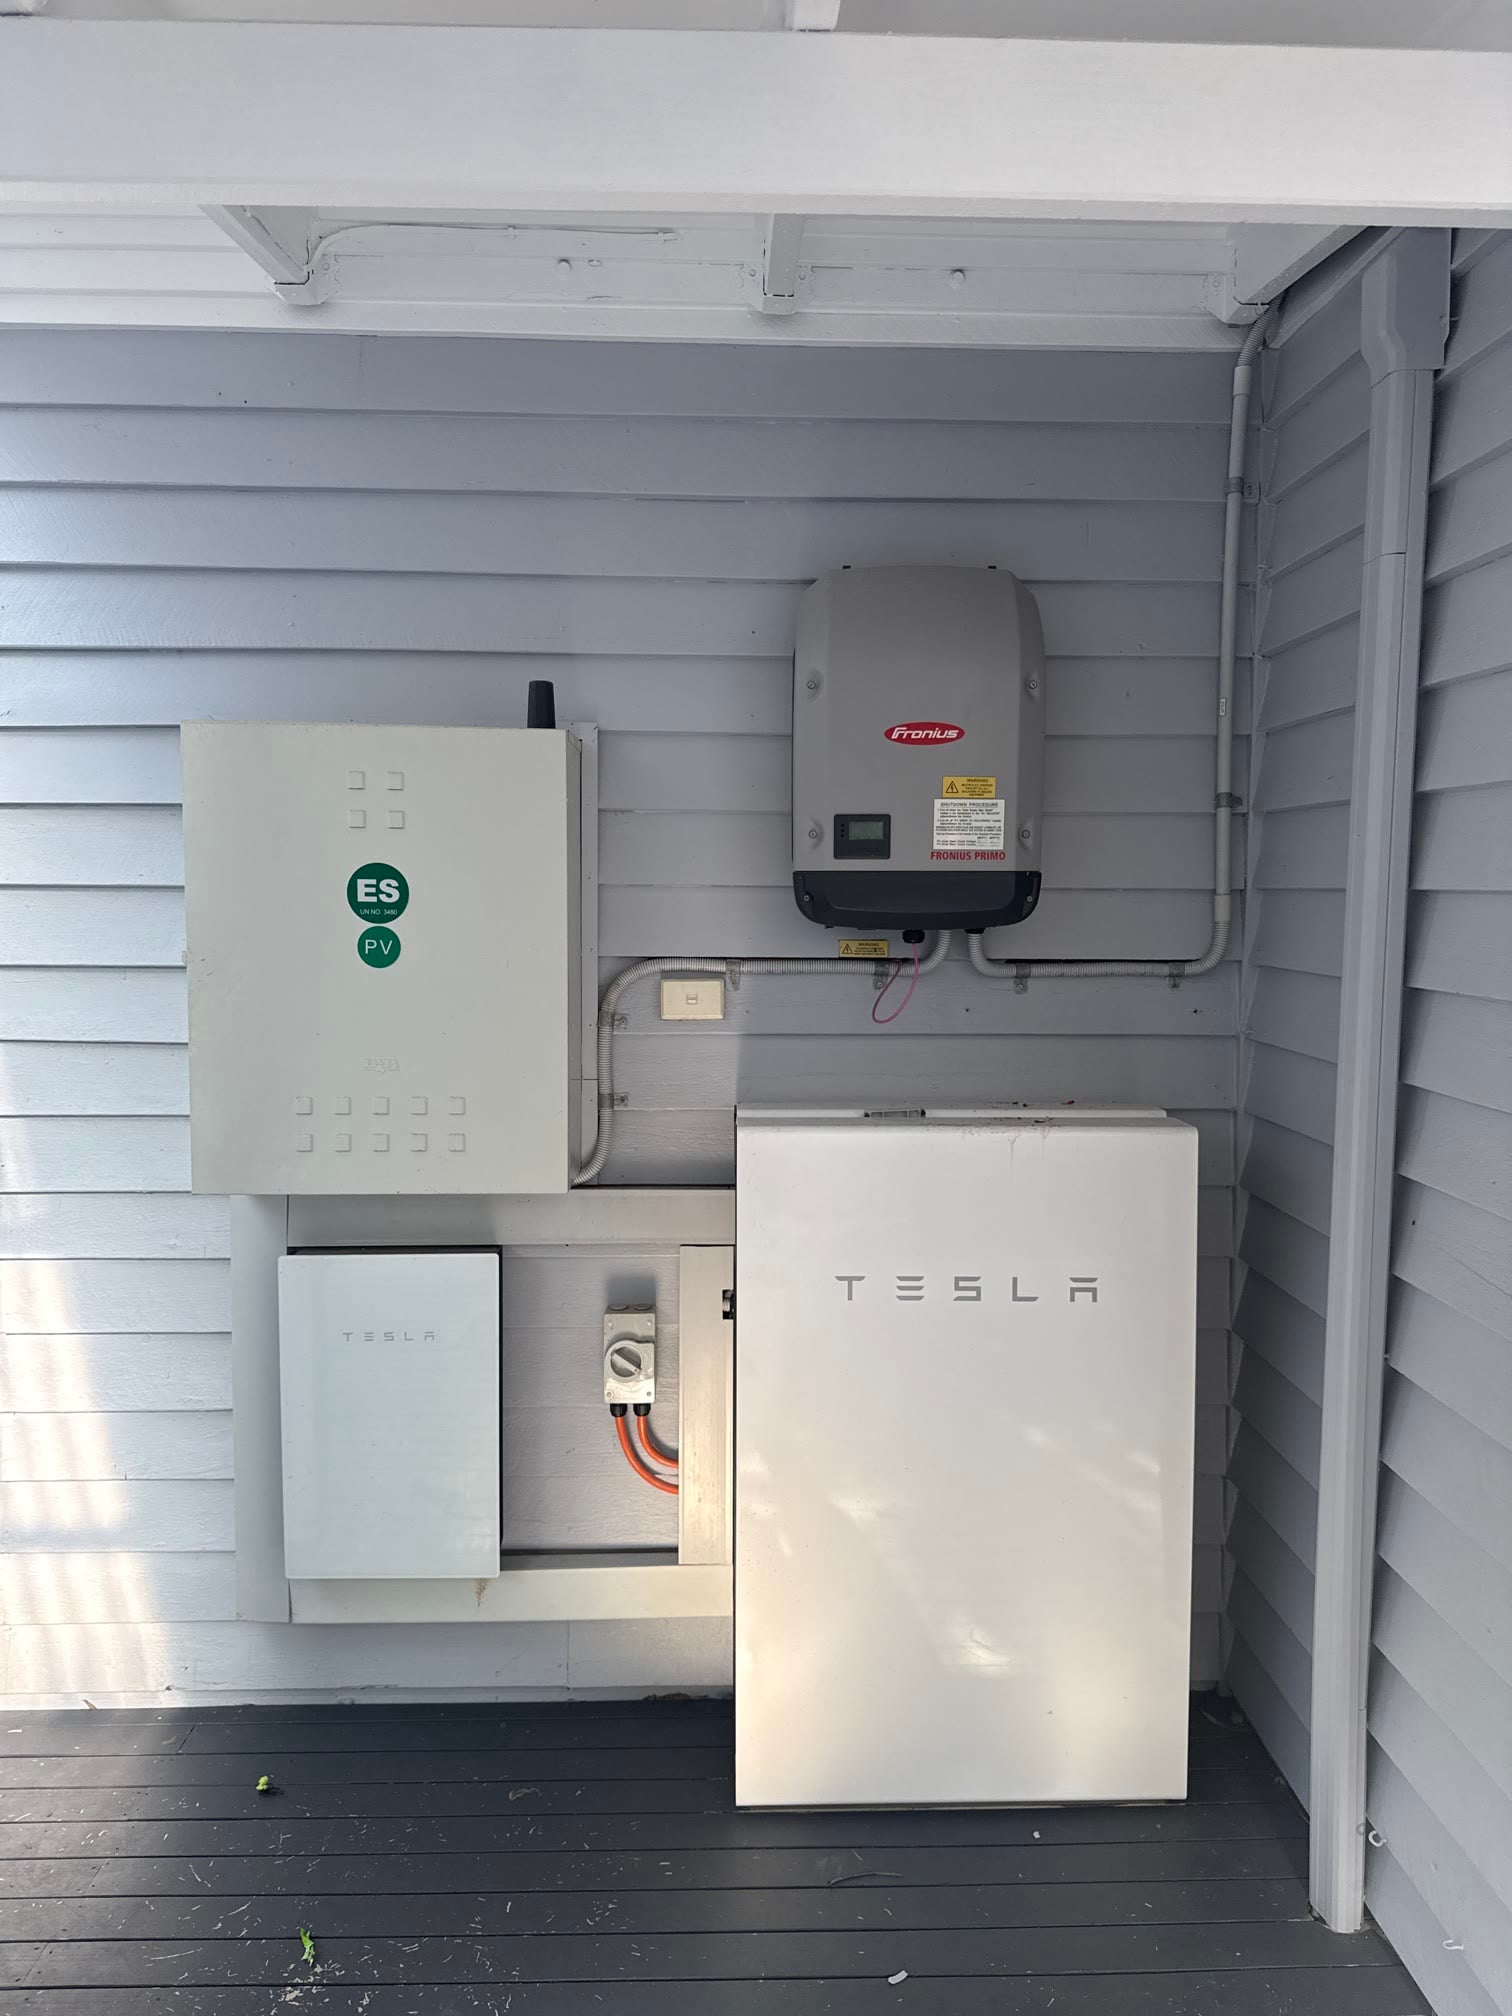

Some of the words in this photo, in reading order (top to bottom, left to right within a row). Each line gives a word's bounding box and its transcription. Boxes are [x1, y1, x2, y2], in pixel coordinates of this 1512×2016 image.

[891, 727, 959, 740] Fronius
[930, 851, 972, 860] FRONIUS
[974, 851, 1006, 860] PRIMO
[356, 878, 401, 903] ES
[364, 939, 393, 955] PV
[835, 1275, 1098, 1303] TESLA
[342, 1331, 435, 1342] TESLA
